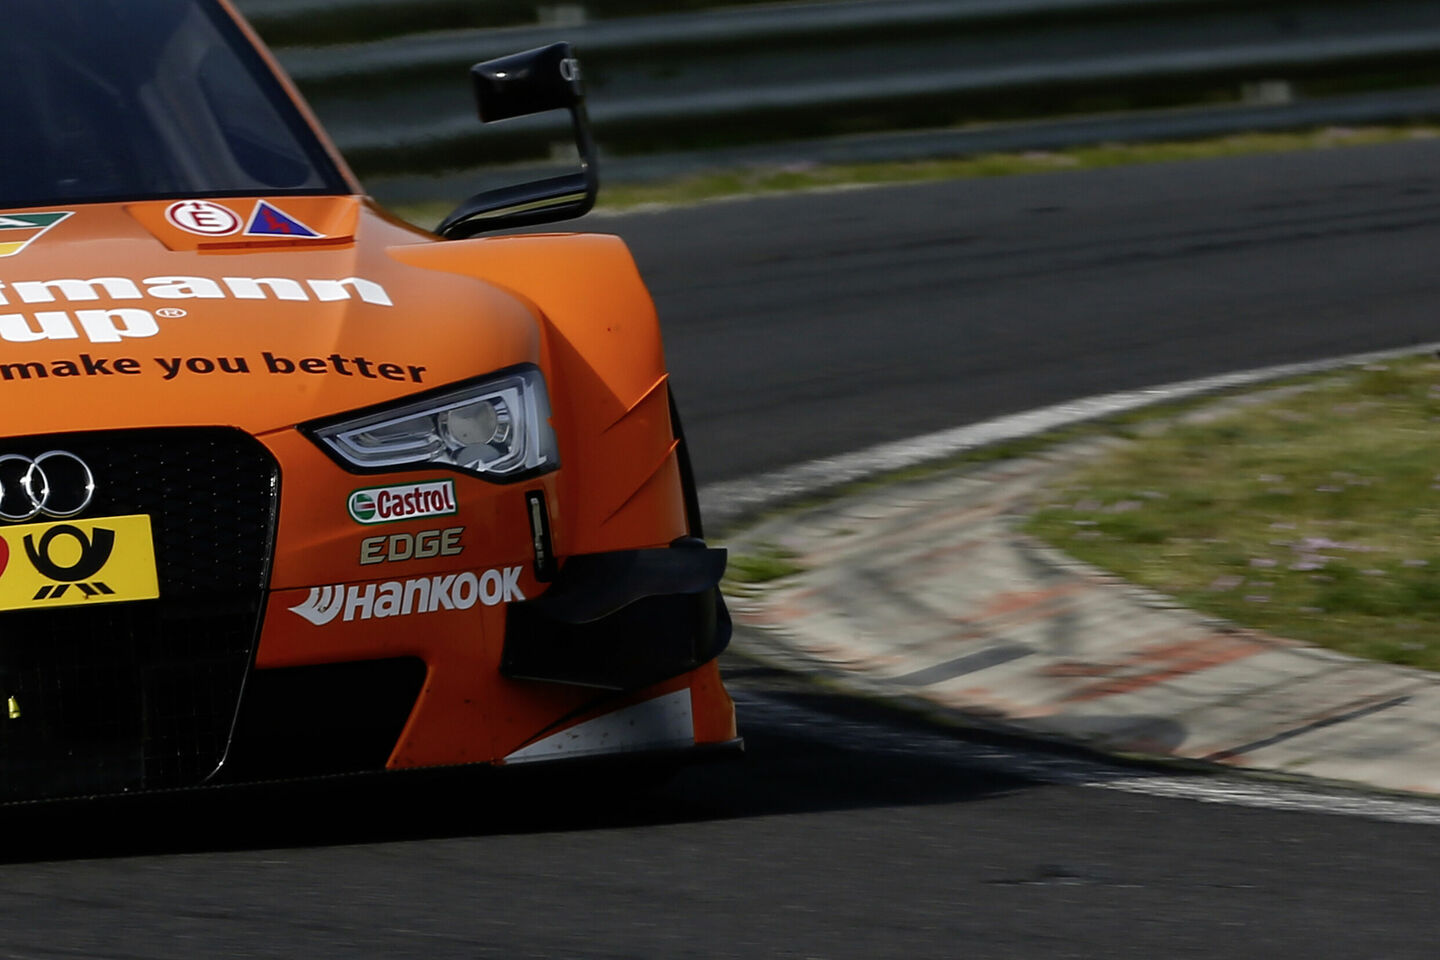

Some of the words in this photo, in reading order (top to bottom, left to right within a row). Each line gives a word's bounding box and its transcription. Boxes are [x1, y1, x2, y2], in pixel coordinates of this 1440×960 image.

[154, 354, 250, 381] you
[261, 352, 428, 383] better
[377, 484, 454, 518] Castrol
[360, 527, 465, 565] EDGE
